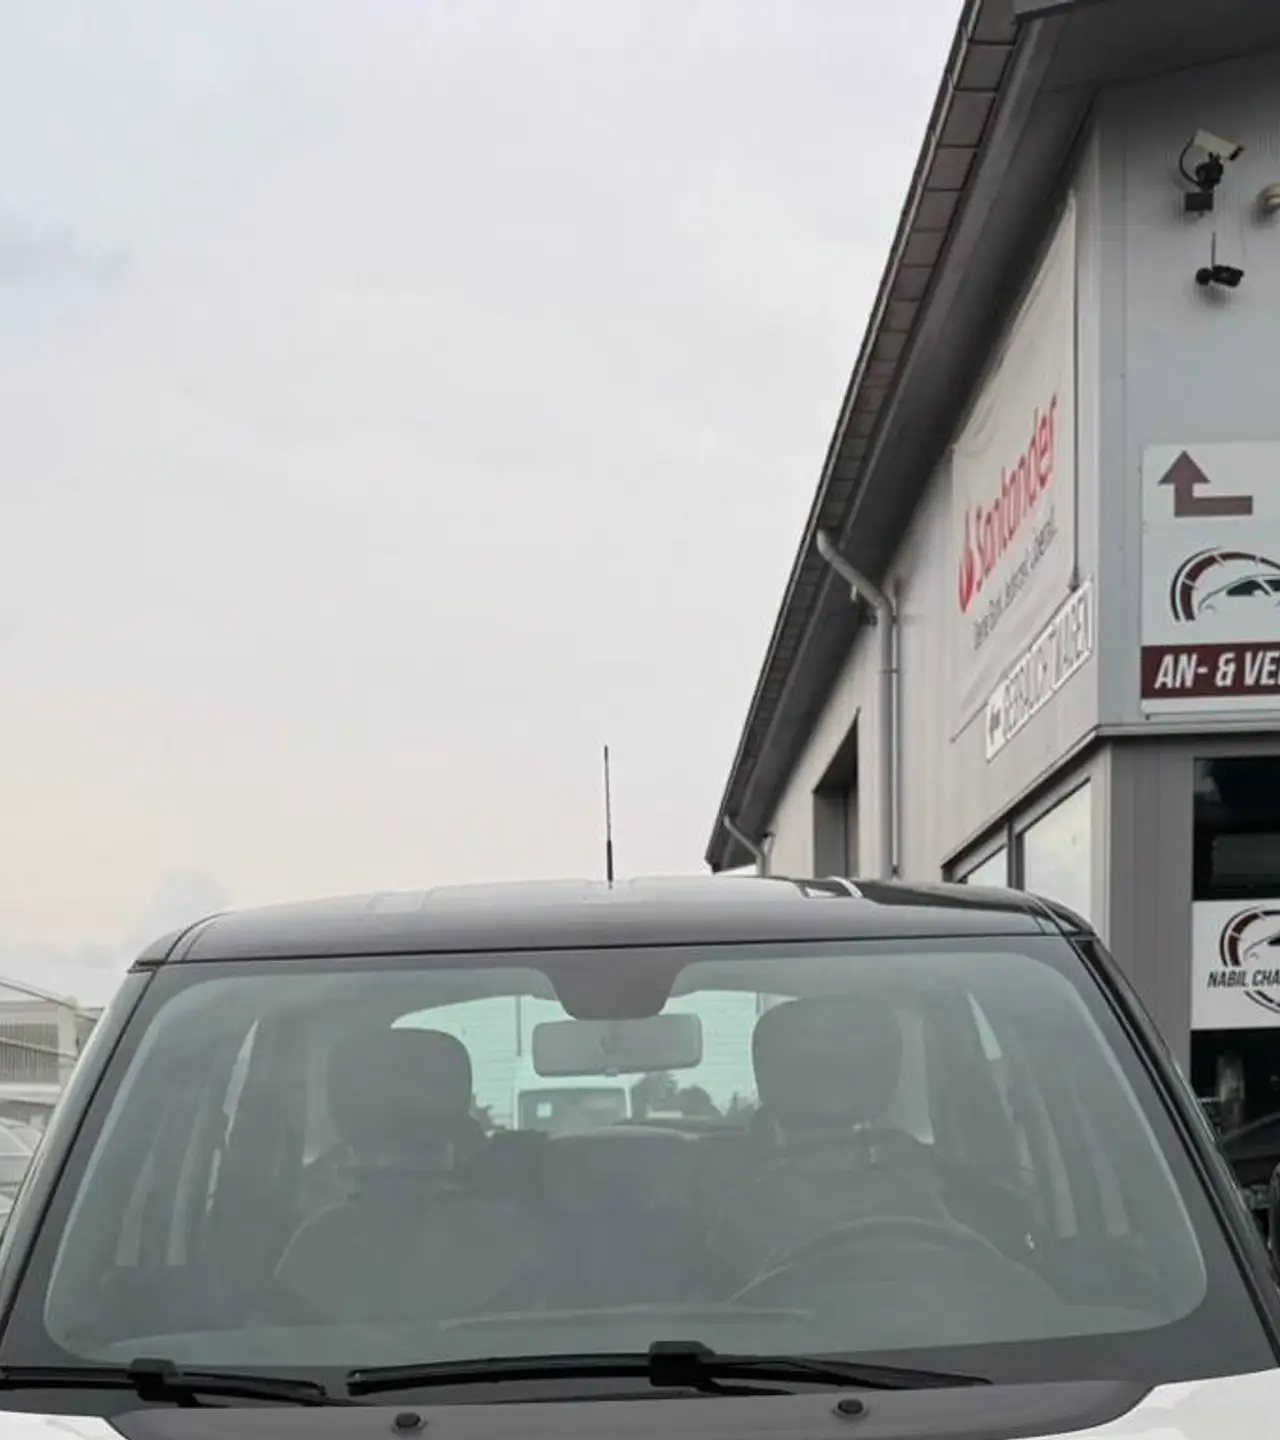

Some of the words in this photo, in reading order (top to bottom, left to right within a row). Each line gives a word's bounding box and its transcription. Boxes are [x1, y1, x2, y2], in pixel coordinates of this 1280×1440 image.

[1154, 652, 1208, 689] AN-
[1215, 648, 1238, 686] &
[1207, 970, 1249, 988] NABIL
